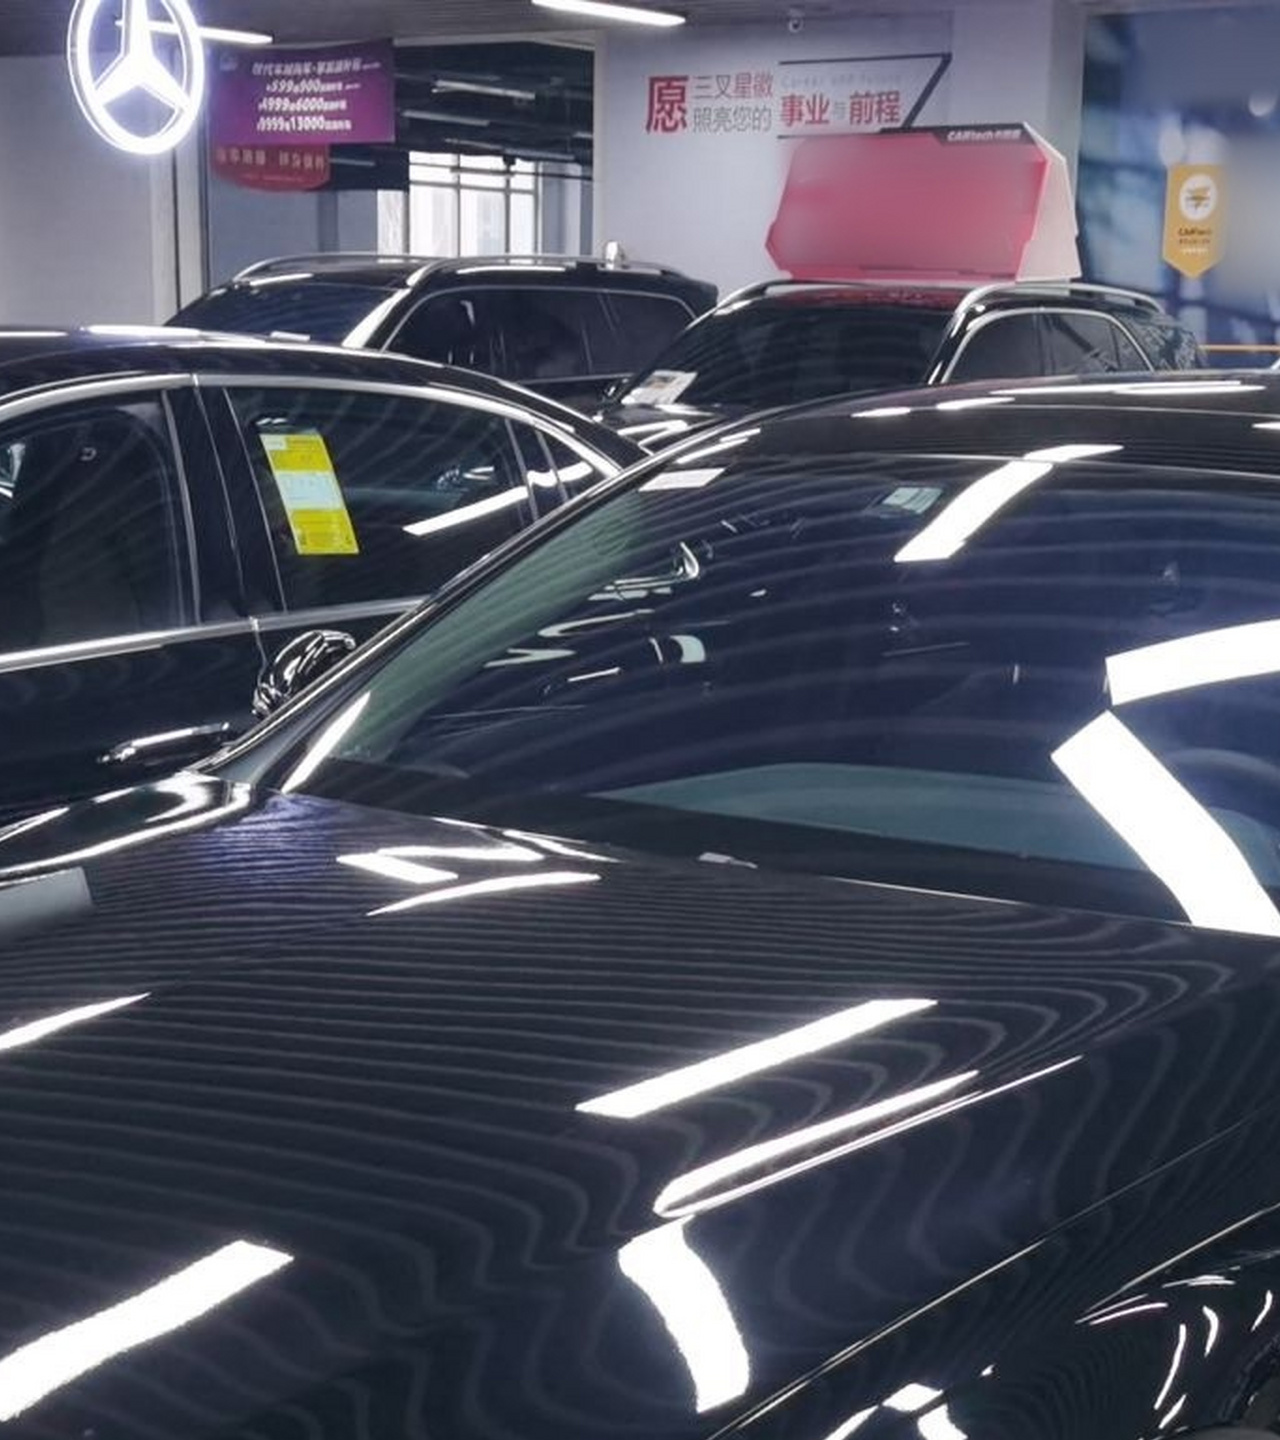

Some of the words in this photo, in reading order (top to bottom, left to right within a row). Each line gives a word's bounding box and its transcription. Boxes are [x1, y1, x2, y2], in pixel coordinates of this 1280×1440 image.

[645, 75, 690, 135] 愿
[693, 104, 773, 135] 照亮您的
